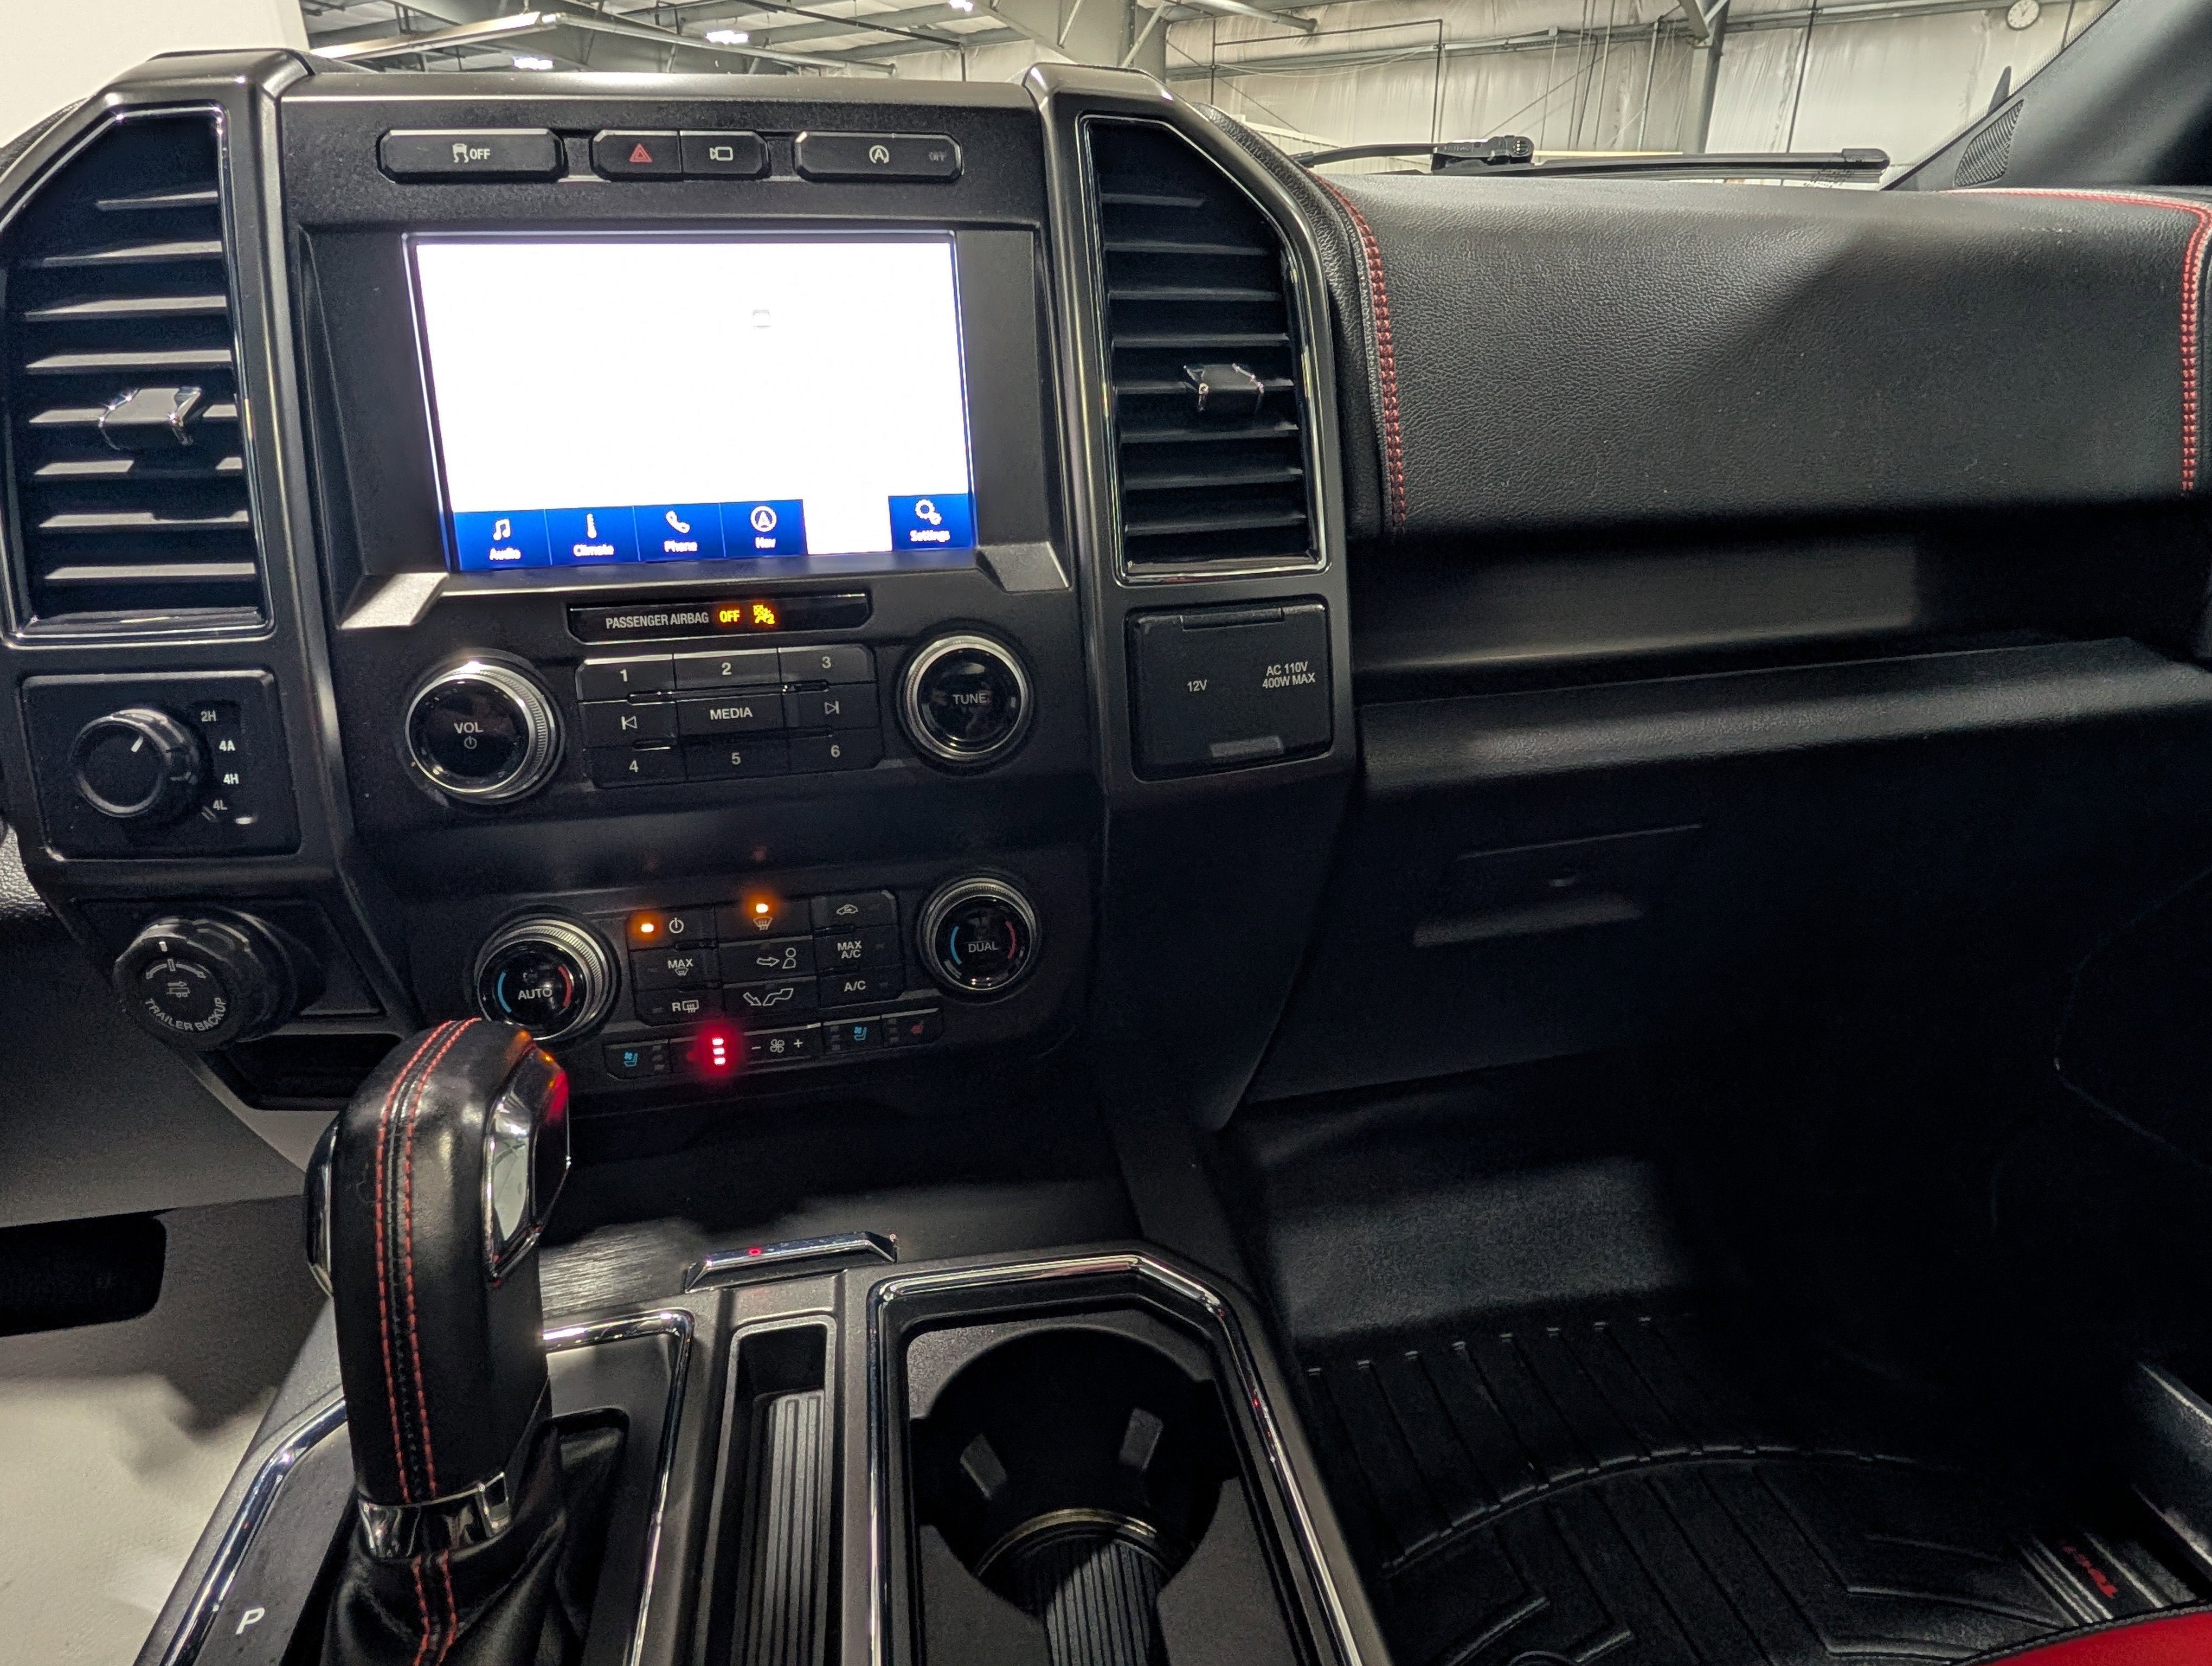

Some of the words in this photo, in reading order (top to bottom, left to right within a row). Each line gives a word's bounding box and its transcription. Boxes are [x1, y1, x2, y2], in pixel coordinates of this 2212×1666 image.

[470, 148, 490, 159] OFF
[910, 529, 950, 542] Settings
[664, 540, 698, 552] Phone
[755, 536, 776, 549] Nav
[489, 548, 521, 560] Audio
[573, 543, 614, 556] Climate
[606, 614, 668, 629] PASSENGER
[670, 612, 709, 625] AIRBAG
[719, 610, 740, 623] OFF
[721, 662, 732, 675] 2
[821, 656, 832, 669] 3
[1266, 665, 1281, 676] AC
[1284, 661, 1308, 674] 110V
[620, 669, 628, 682] 1
[1262, 676, 1290, 689] 400W
[1293, 672, 1316, 684] MAX
[1187, 680, 1207, 692] 12V
[953, 693, 987, 705] TUNE
[201, 710, 217, 722] 2H
[710, 706, 753, 720] MEDIA
[454, 722, 483, 734] VOL
[219, 740, 236, 752] 4A
[831, 745, 840, 758] 6
[731, 752, 741, 765] 5
[628, 760, 639, 773] 4
[223, 773, 240, 785] 4H
[213, 799, 228, 811] 4L
[837, 941, 862, 952] MAX
[968, 941, 999, 953] DUAL
[841, 948, 861, 959] A/C
[667, 958, 693, 969] MAX
[844, 981, 866, 992] A/C
[518, 988, 553, 1000] AUTO
[672, 1002, 681, 1012] R
[145, 998, 194, 1031] TRAILER
[195, 997, 227, 1031] BACKUP
[235, 1607, 265, 1635] P
